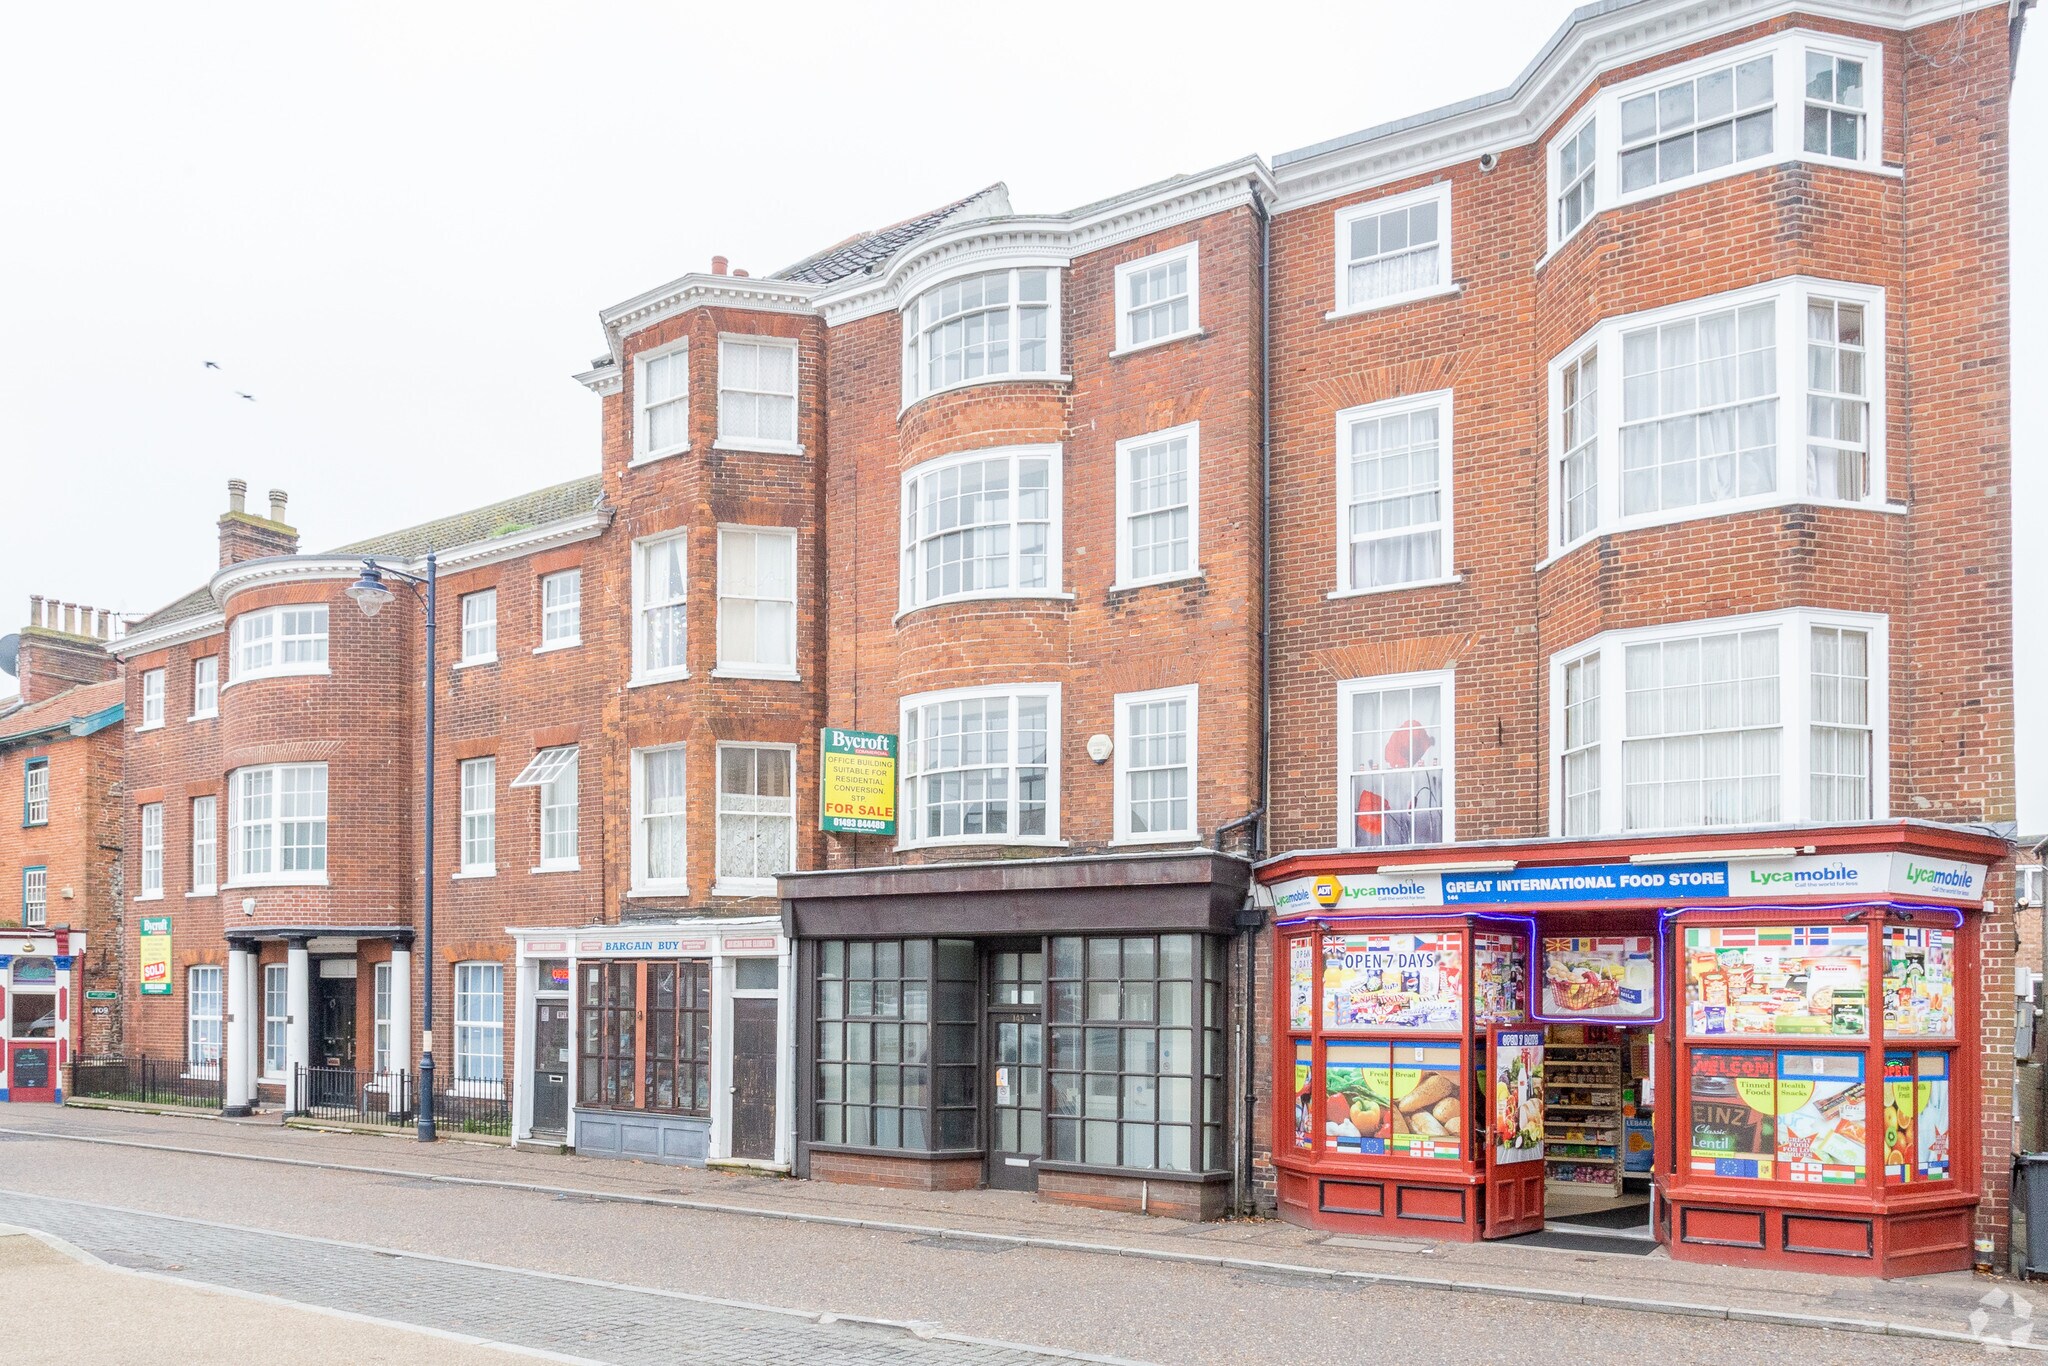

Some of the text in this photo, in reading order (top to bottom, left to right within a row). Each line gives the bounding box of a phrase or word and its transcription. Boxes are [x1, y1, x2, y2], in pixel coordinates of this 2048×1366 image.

[832, 730, 889, 751] Bycroft
[828, 756, 892, 768] OFFICE BUILDING
[834, 766, 869, 774] SUITABLE
[836, 776, 884, 785] RESIDENTIAL
[826, 803, 893, 817] FOR SALE
[834, 818, 856, 828] 01493
[1750, 867, 1858, 885] Lycamobile
[1907, 862, 1972, 888] Lycamobile
[1446, 872, 1725, 893] GREAT INTERNATIONAL FOOD STORE
[1318, 886, 1331, 896] ADT
[1344, 883, 1425, 898] Lycamobile
[1276, 888, 1310, 907] Lycamobile
[605, 942, 652, 950] BARGAIN
[658, 941, 679, 950] BUY
[1345, 953, 1434, 968] OPEN 7 DAYS
[145, 963, 165, 977] SOLD
[552, 968, 568, 979] OPE
[1503, 1034, 1538, 1046] OPEN 7 DAYS
[1695, 1124, 1727, 1135] Classic
[1693, 1136, 1728, 1148] Lentil
